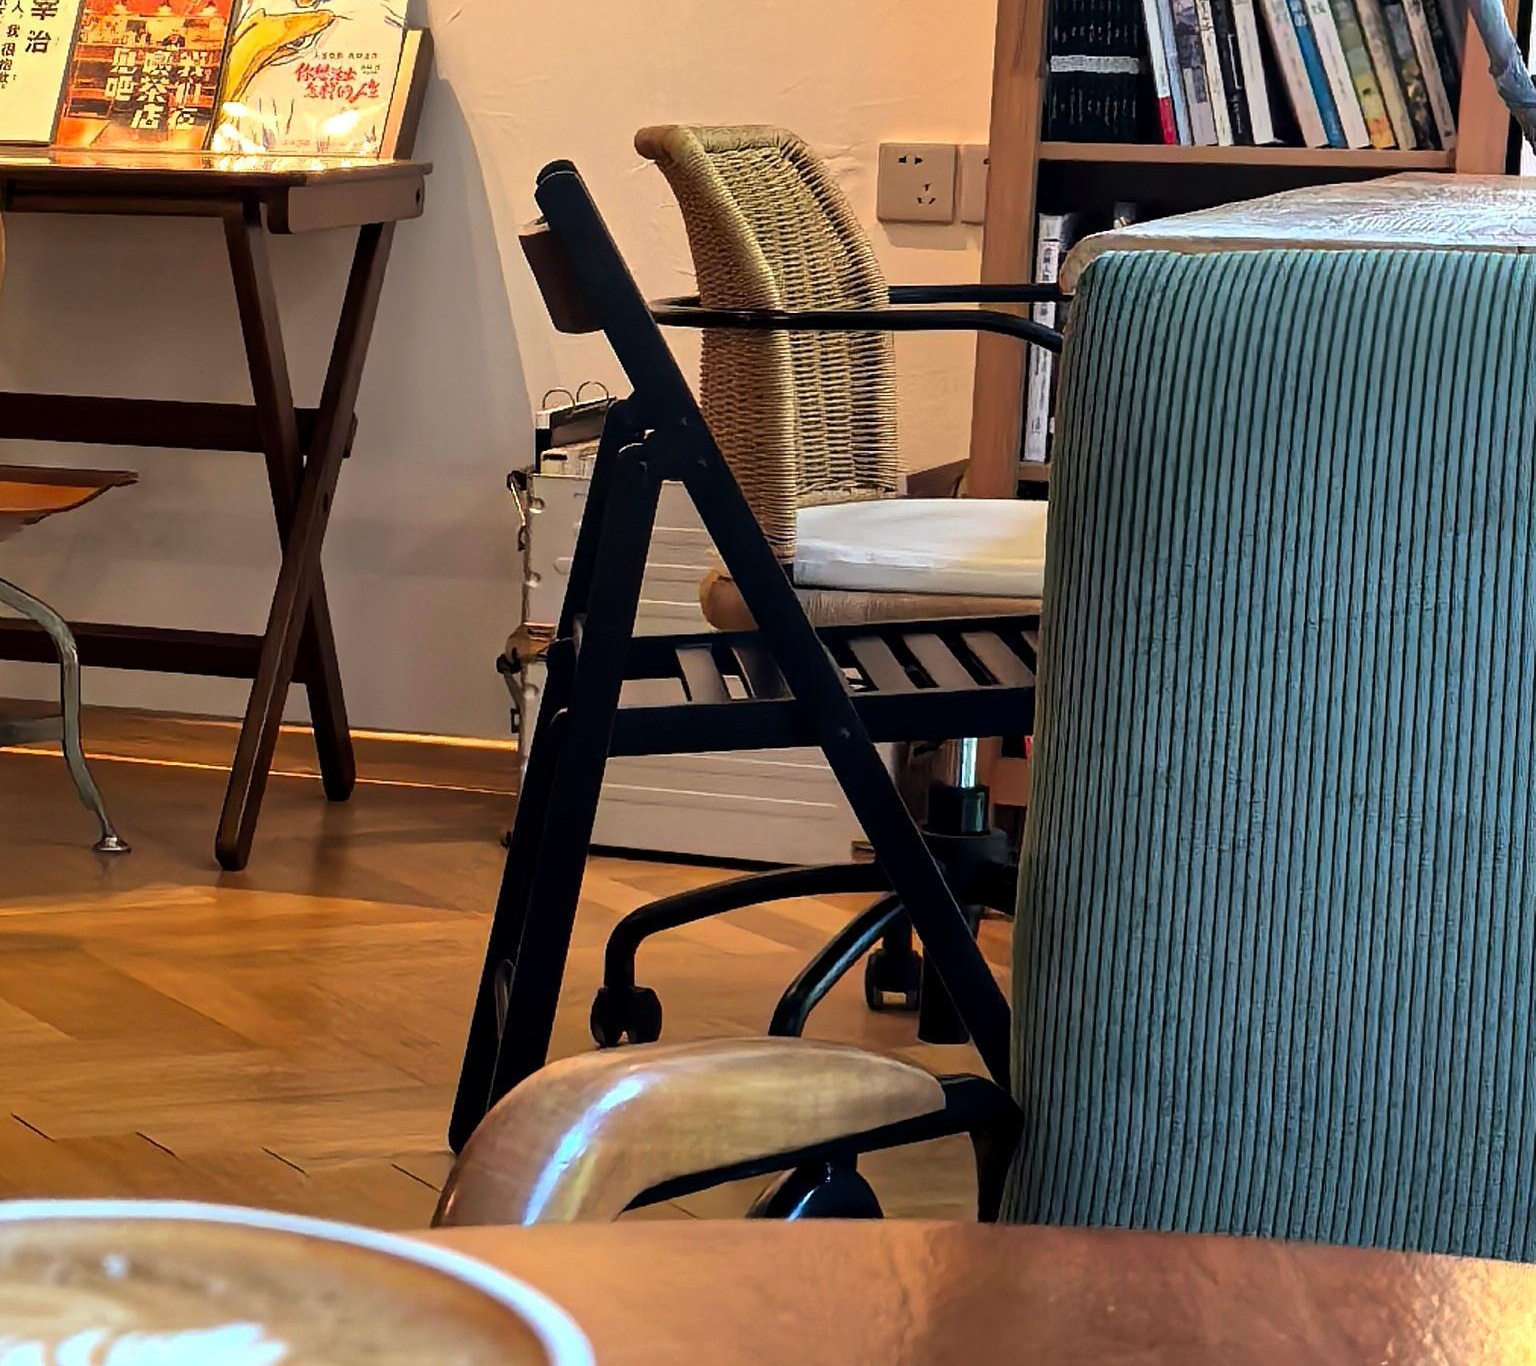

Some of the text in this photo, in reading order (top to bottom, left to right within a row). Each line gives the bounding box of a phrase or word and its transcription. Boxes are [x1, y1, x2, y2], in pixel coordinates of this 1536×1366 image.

[295, 62, 357, 82] 你想活出
[303, 78, 380, 103] 怎样的人生
